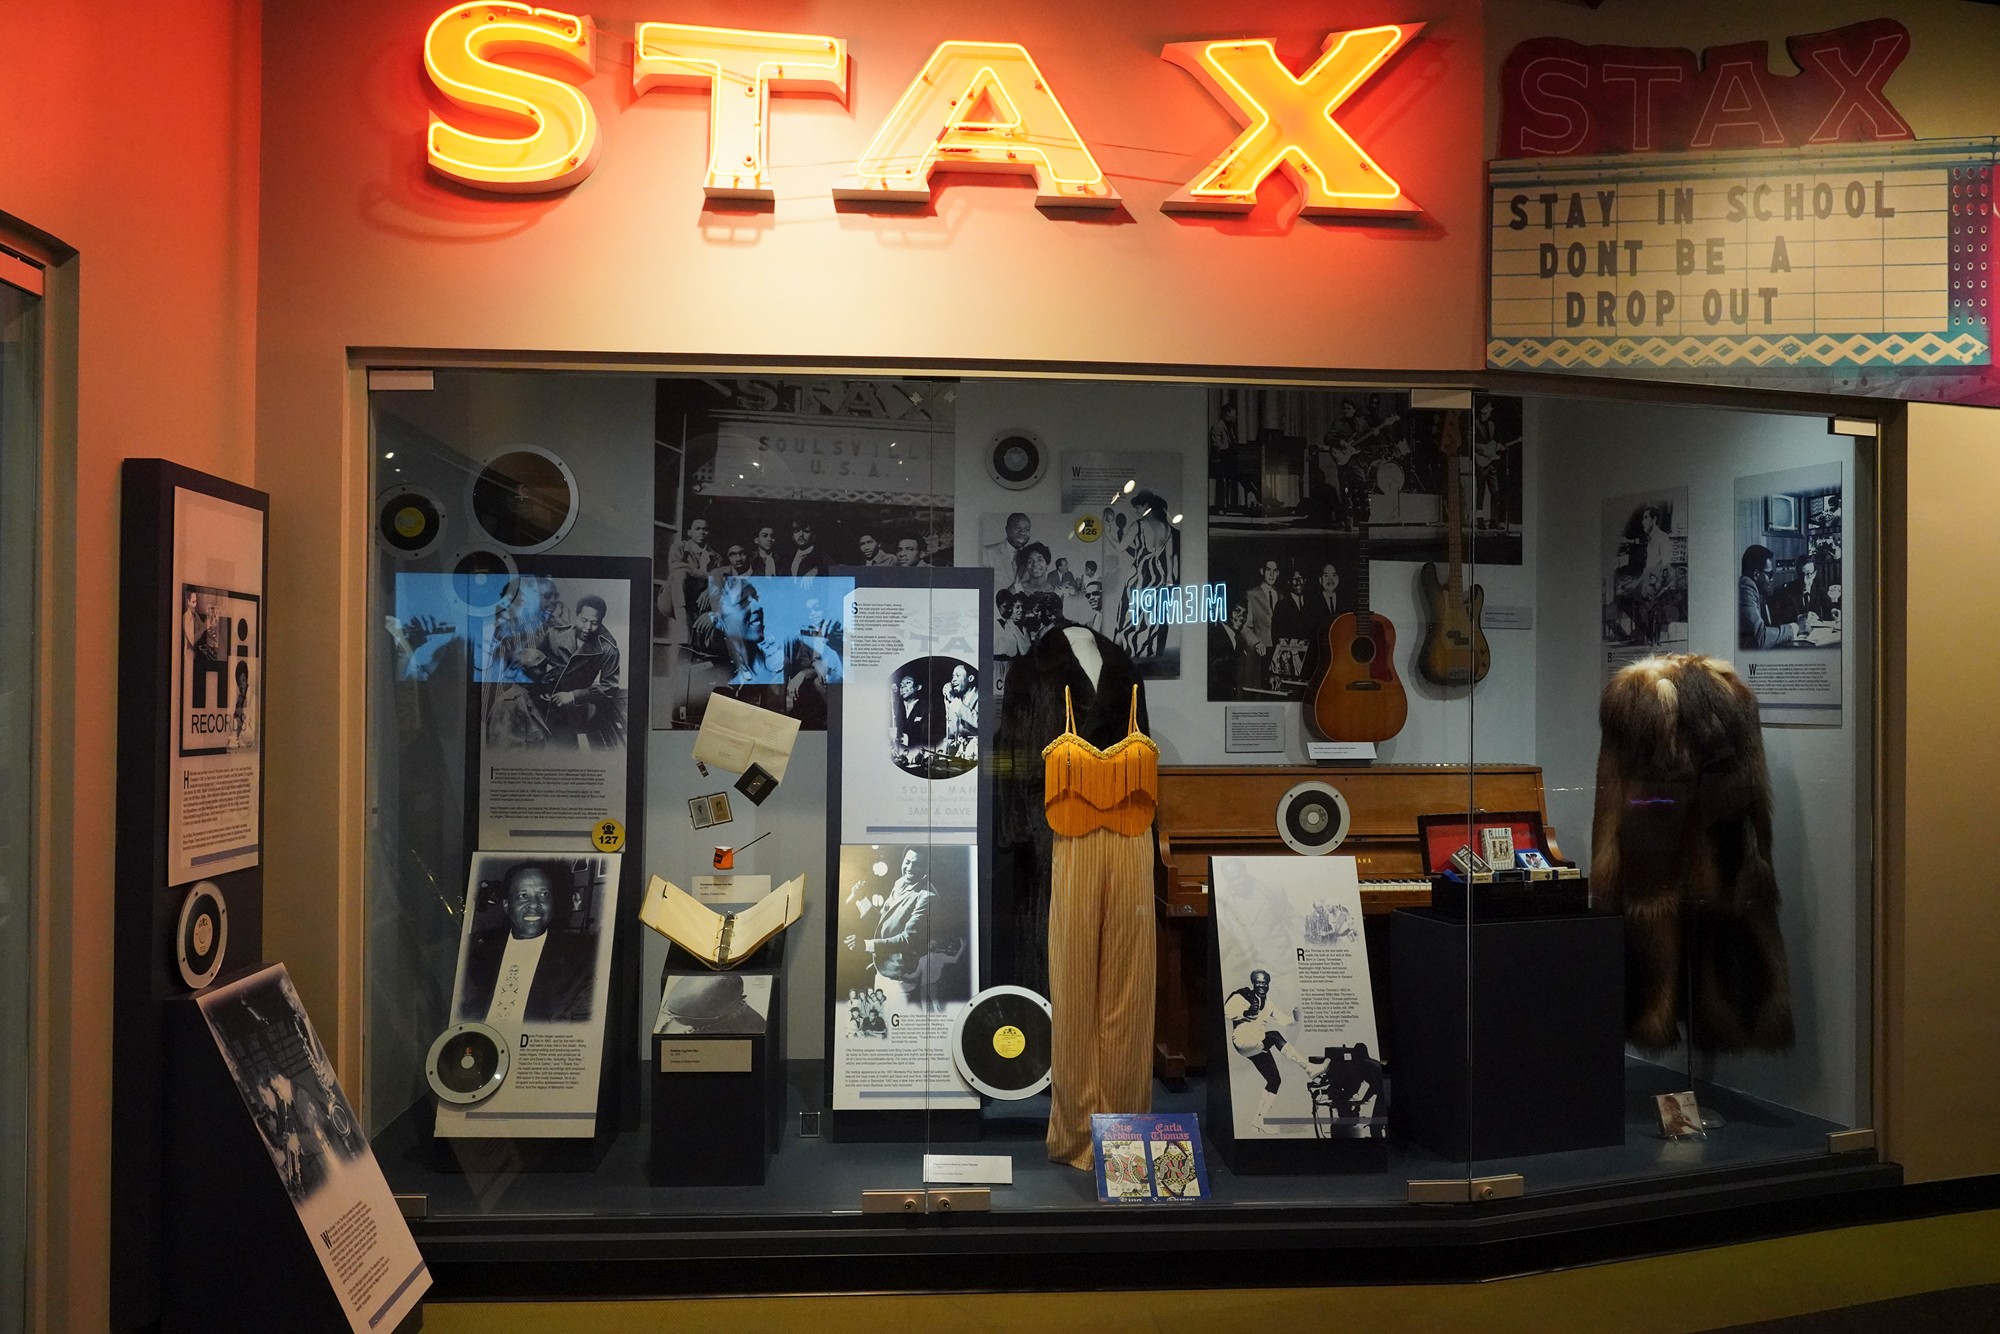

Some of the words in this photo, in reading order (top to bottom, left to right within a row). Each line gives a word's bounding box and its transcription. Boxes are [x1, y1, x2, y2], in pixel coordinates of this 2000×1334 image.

[1520, 34, 1907, 154] STAX
[424, 1, 1426, 219] STAX
[1508, 191, 1617, 230] STAY
[1658, 188, 1694, 225] IN
[1726, 181, 1895, 223] SCHOOL
[1539, 240, 1643, 279] DONT
[1676, 238, 1726, 276] BE
[1770, 236, 1792, 273] A
[1567, 290, 1675, 328] DROP
[1702, 288, 1778, 326] OUT
[759, 436, 937, 461] SOULSVILL
[1081, 528, 1097, 536] 126
[945, 807, 971, 816] DAVE
[598, 836, 618, 844] 127
[1151, 1131, 1190, 1140] Thomas
[1155, 1123, 1183, 1133] Carla
